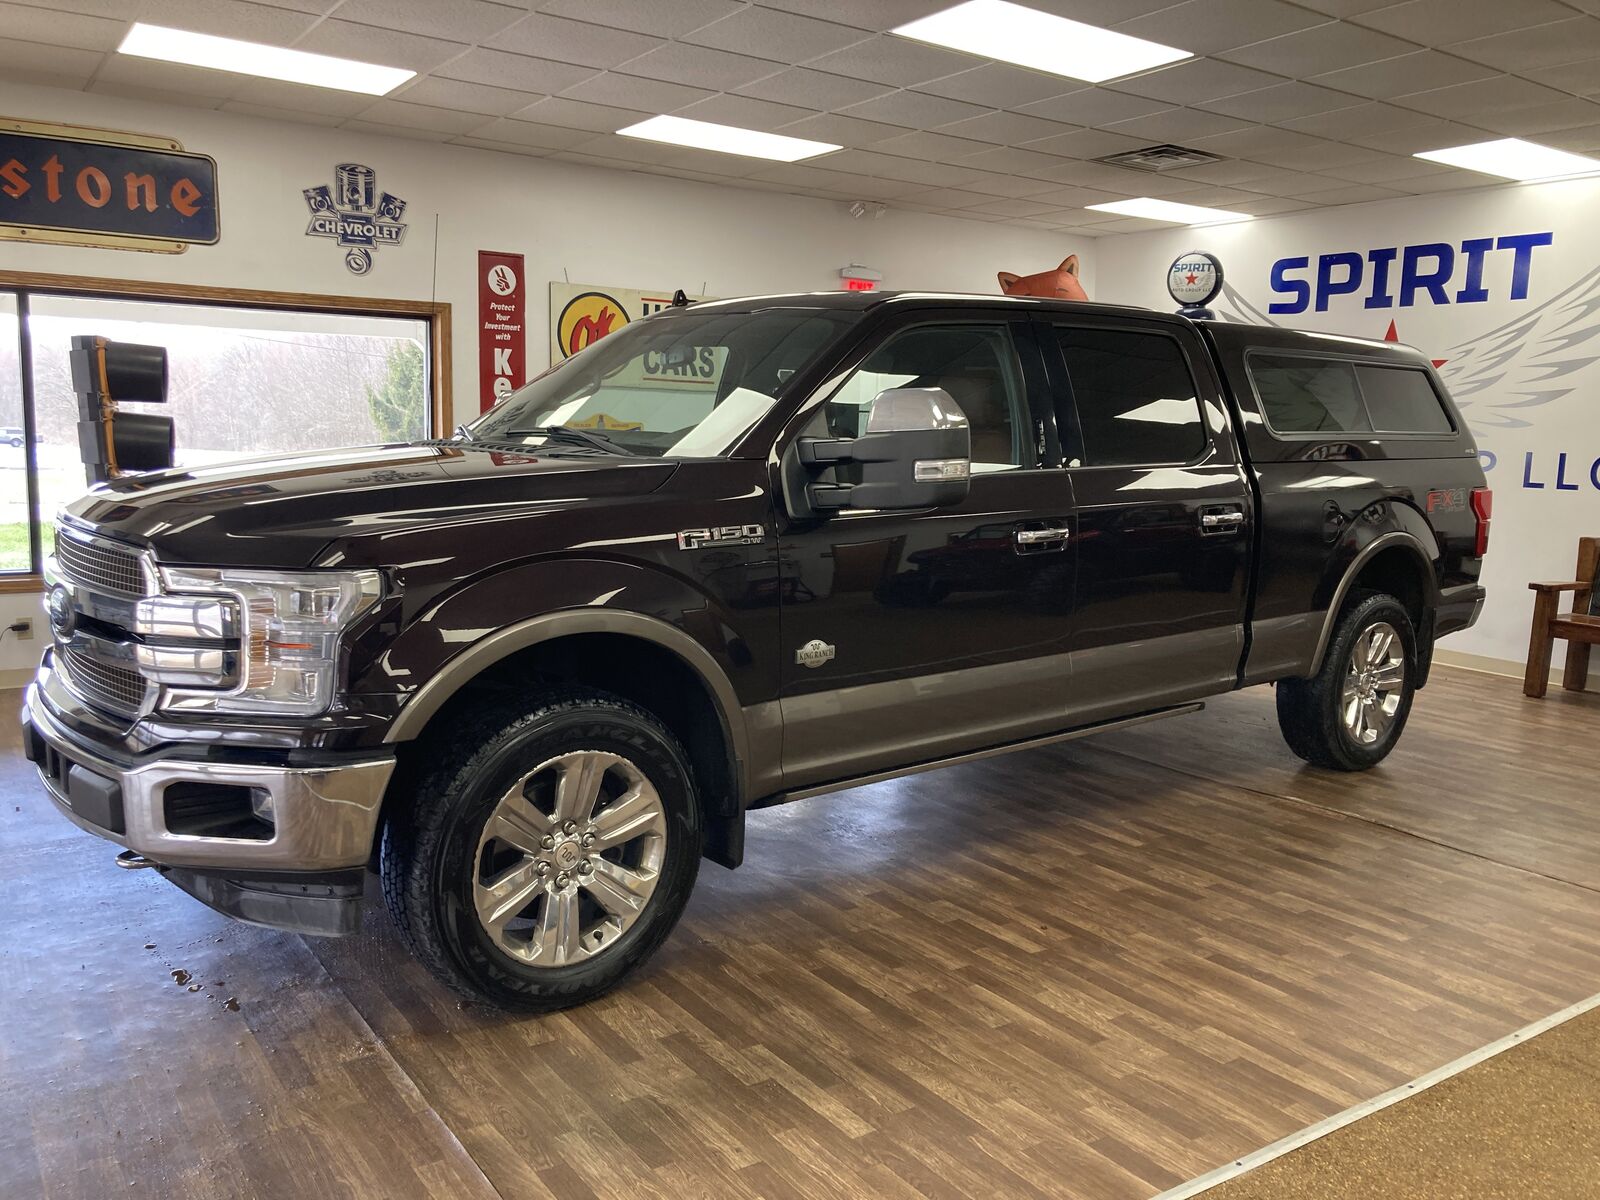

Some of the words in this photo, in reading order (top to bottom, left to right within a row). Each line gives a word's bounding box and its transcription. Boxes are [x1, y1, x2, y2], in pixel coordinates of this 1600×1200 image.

[315, 220, 398, 239] CHEVROLET
[1173, 263, 1213, 273] SPIRIT
[1268, 232, 1553, 315] SPIRIT
[489, 302, 516, 312] Protect
[495, 313, 511, 321] Your
[484, 322, 521, 332] Investment
[495, 333, 511, 341] with
[1427, 488, 1466, 512] FX4
